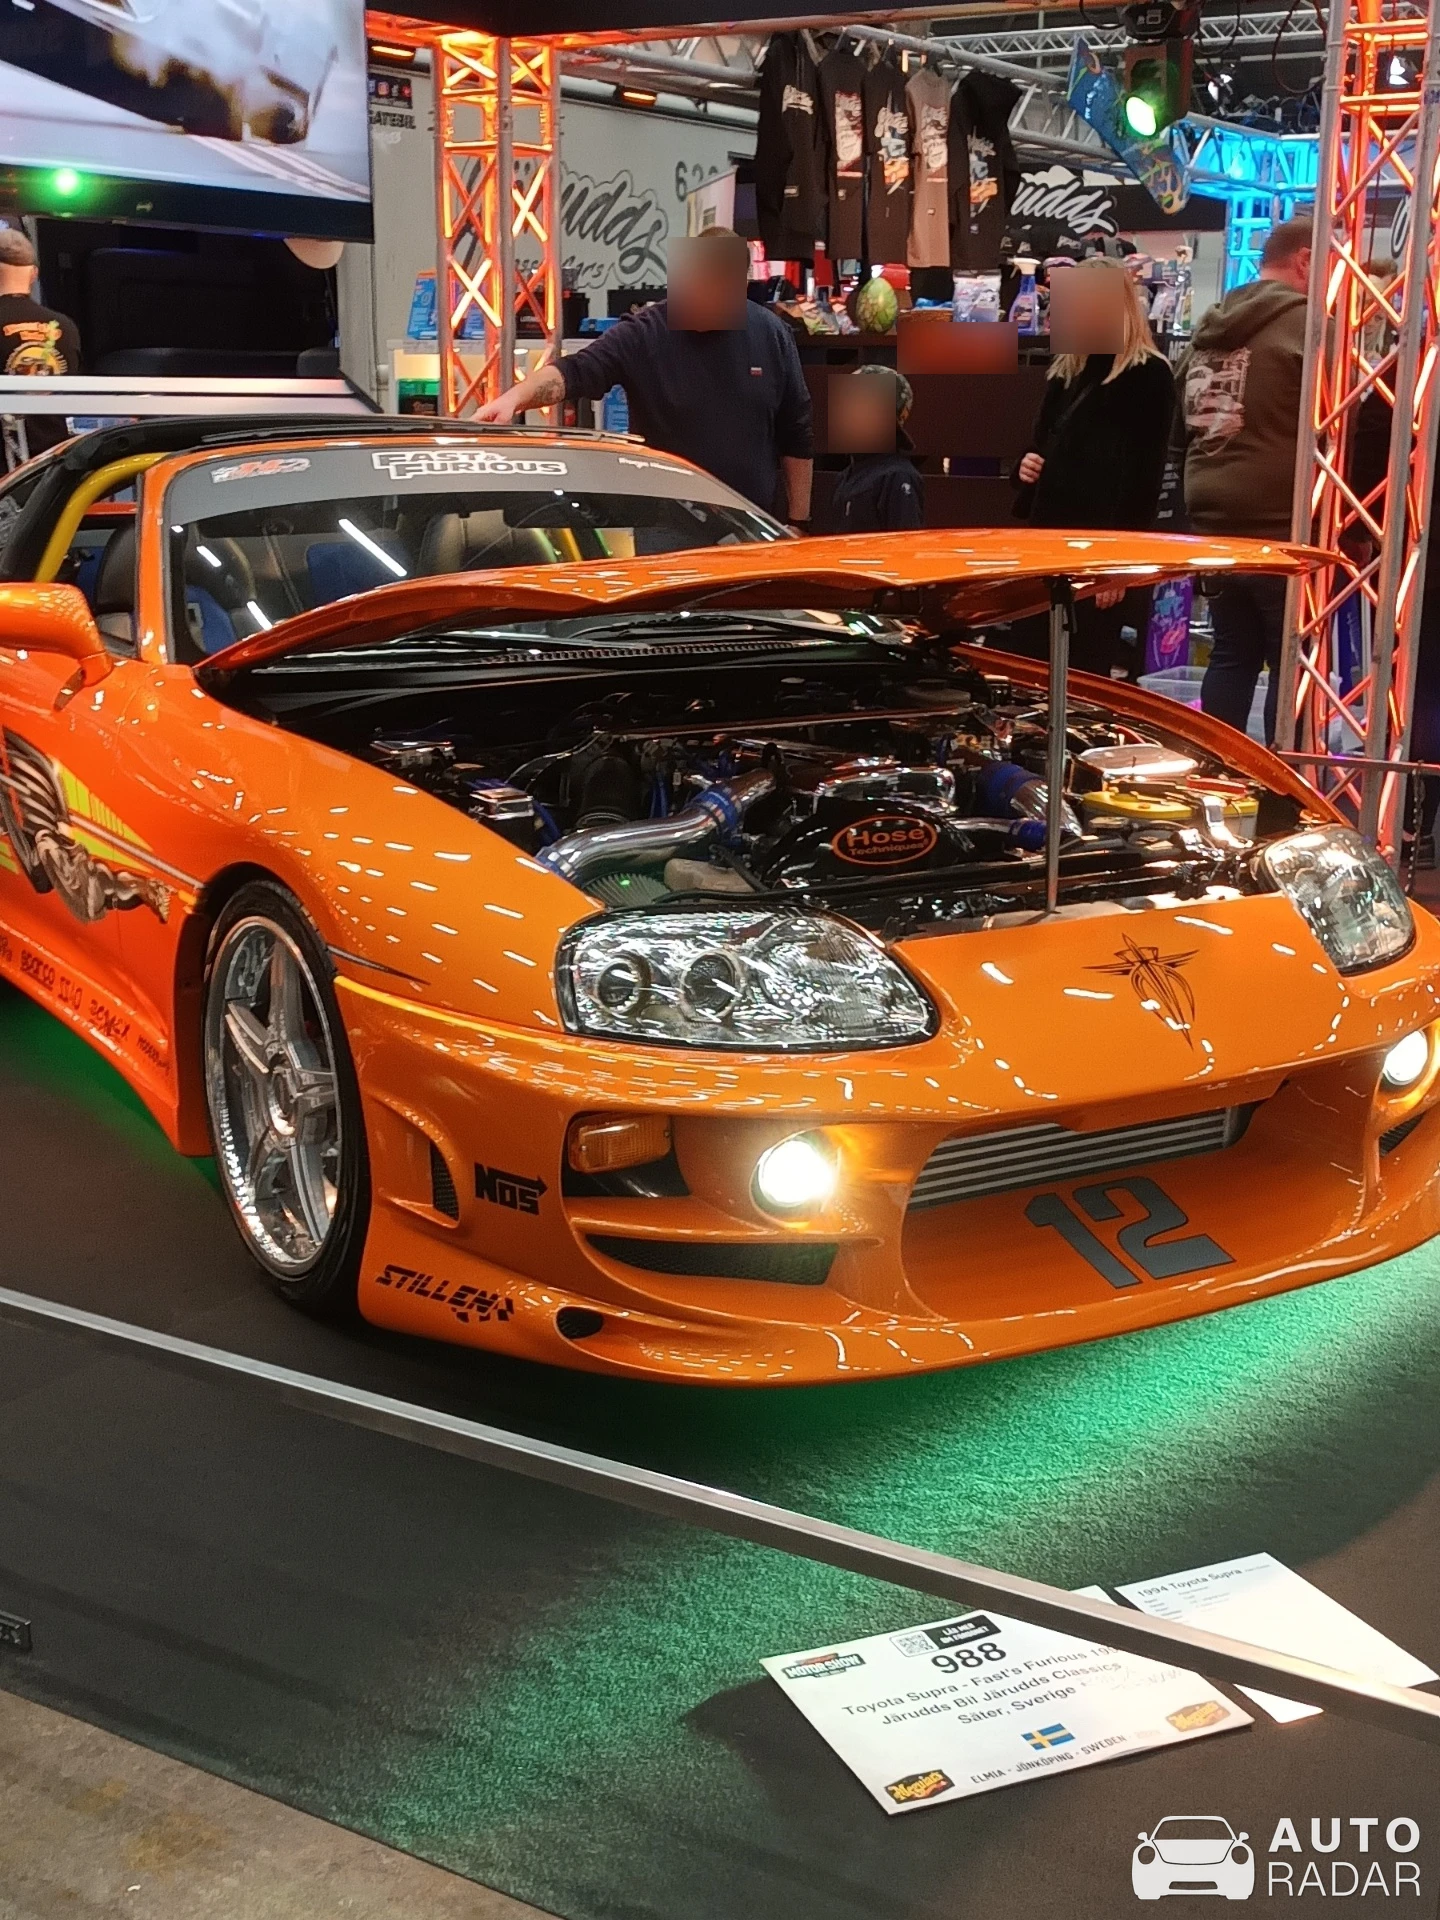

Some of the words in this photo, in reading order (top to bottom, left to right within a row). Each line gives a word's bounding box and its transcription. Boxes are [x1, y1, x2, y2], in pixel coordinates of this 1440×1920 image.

[371, 450, 481, 470] FAST
[389, 460, 568, 480] FURIOUS
[846, 828, 925, 847] Hose
[474, 1162, 548, 1216] NOS
[1023, 1176, 1236, 1289] 12
[1169, 1576, 1209, 1590] Toyota
[1208, 1568, 1243, 1581] Supra
[931, 1641, 1007, 1675] 988
[841, 1696, 905, 1716] Toyota
[906, 1684, 959, 1703] Supra
[970, 1666, 1023, 1687] Fast's
[1023, 1653, 1088, 1671] Furious
[882, 1703, 951, 1726] Järudds
[954, 1694, 979, 1710] Bil
[983, 1675, 1050, 1702] Järudds
[1052, 1660, 1122, 1680] Classics
[957, 1706, 1011, 1725] Säter,
[1011, 1685, 1077, 1712] Sverige
[971, 1768, 1006, 1784] ELMIA
[1015, 1750, 1075, 1774] JÖNKÖPING
[1080, 1734, 1127, 1756] SWEDEN
